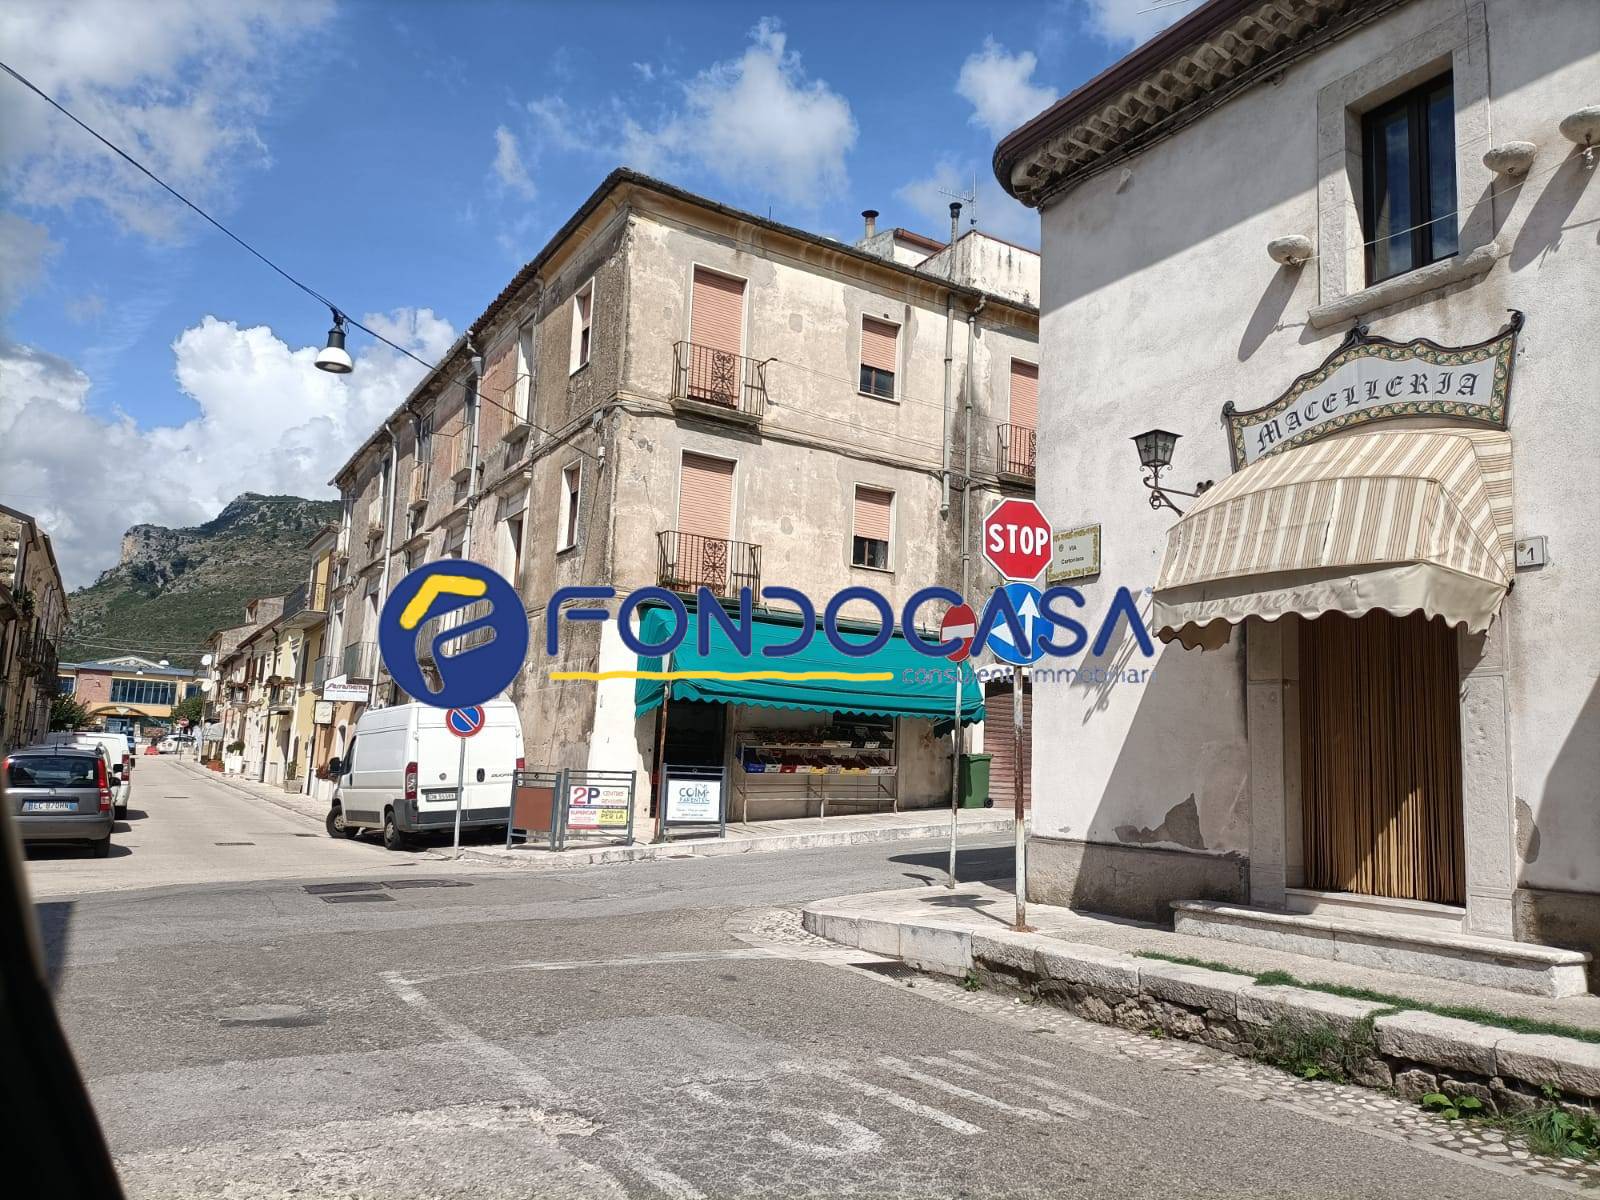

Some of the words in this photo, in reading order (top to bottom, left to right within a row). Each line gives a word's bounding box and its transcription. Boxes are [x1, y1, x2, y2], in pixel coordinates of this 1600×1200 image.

[1257, 372, 1480, 453] MACELLERIA
[988, 523, 1049, 556] STOP
[1526, 547, 1534, 561] 1
[573, 787, 601, 805] 2P
